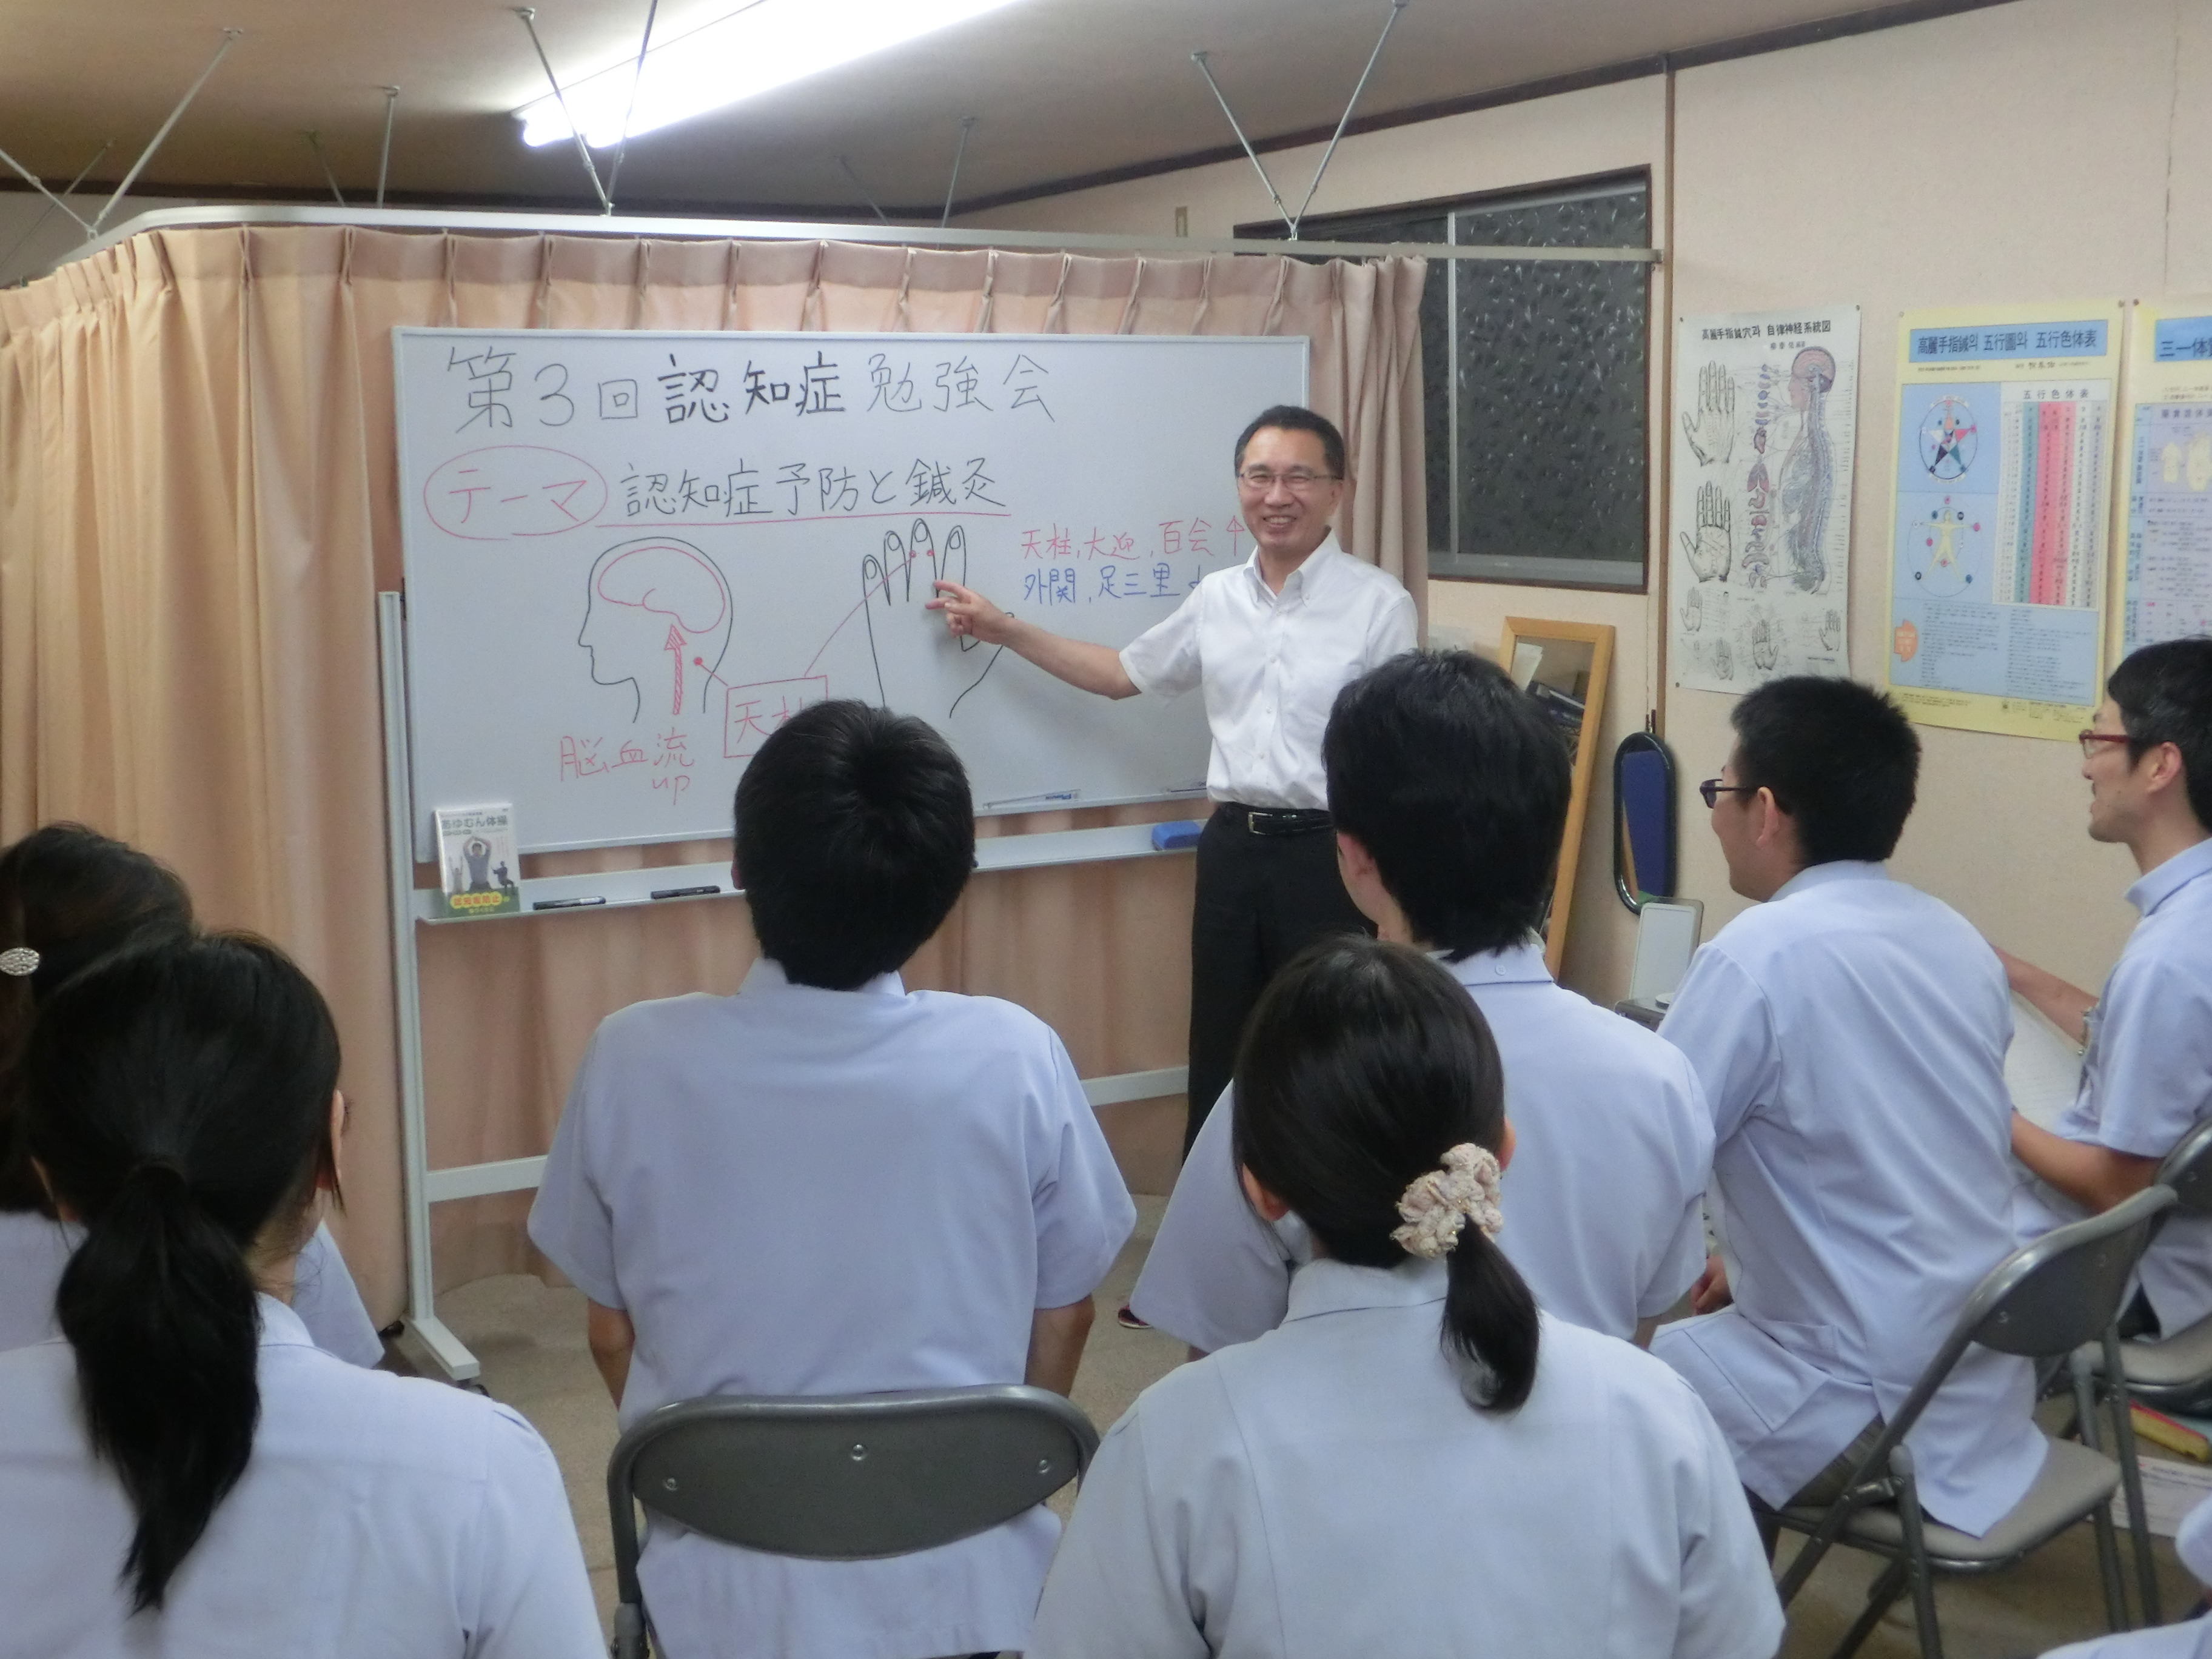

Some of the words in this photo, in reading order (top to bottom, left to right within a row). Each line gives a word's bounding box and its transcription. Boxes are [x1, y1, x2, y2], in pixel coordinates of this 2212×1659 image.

[449, 469, 587, 523] テーマ
[620, 457, 1007, 517] 認知症予防と鍼灸
[560, 726, 695, 783] 脳血流
